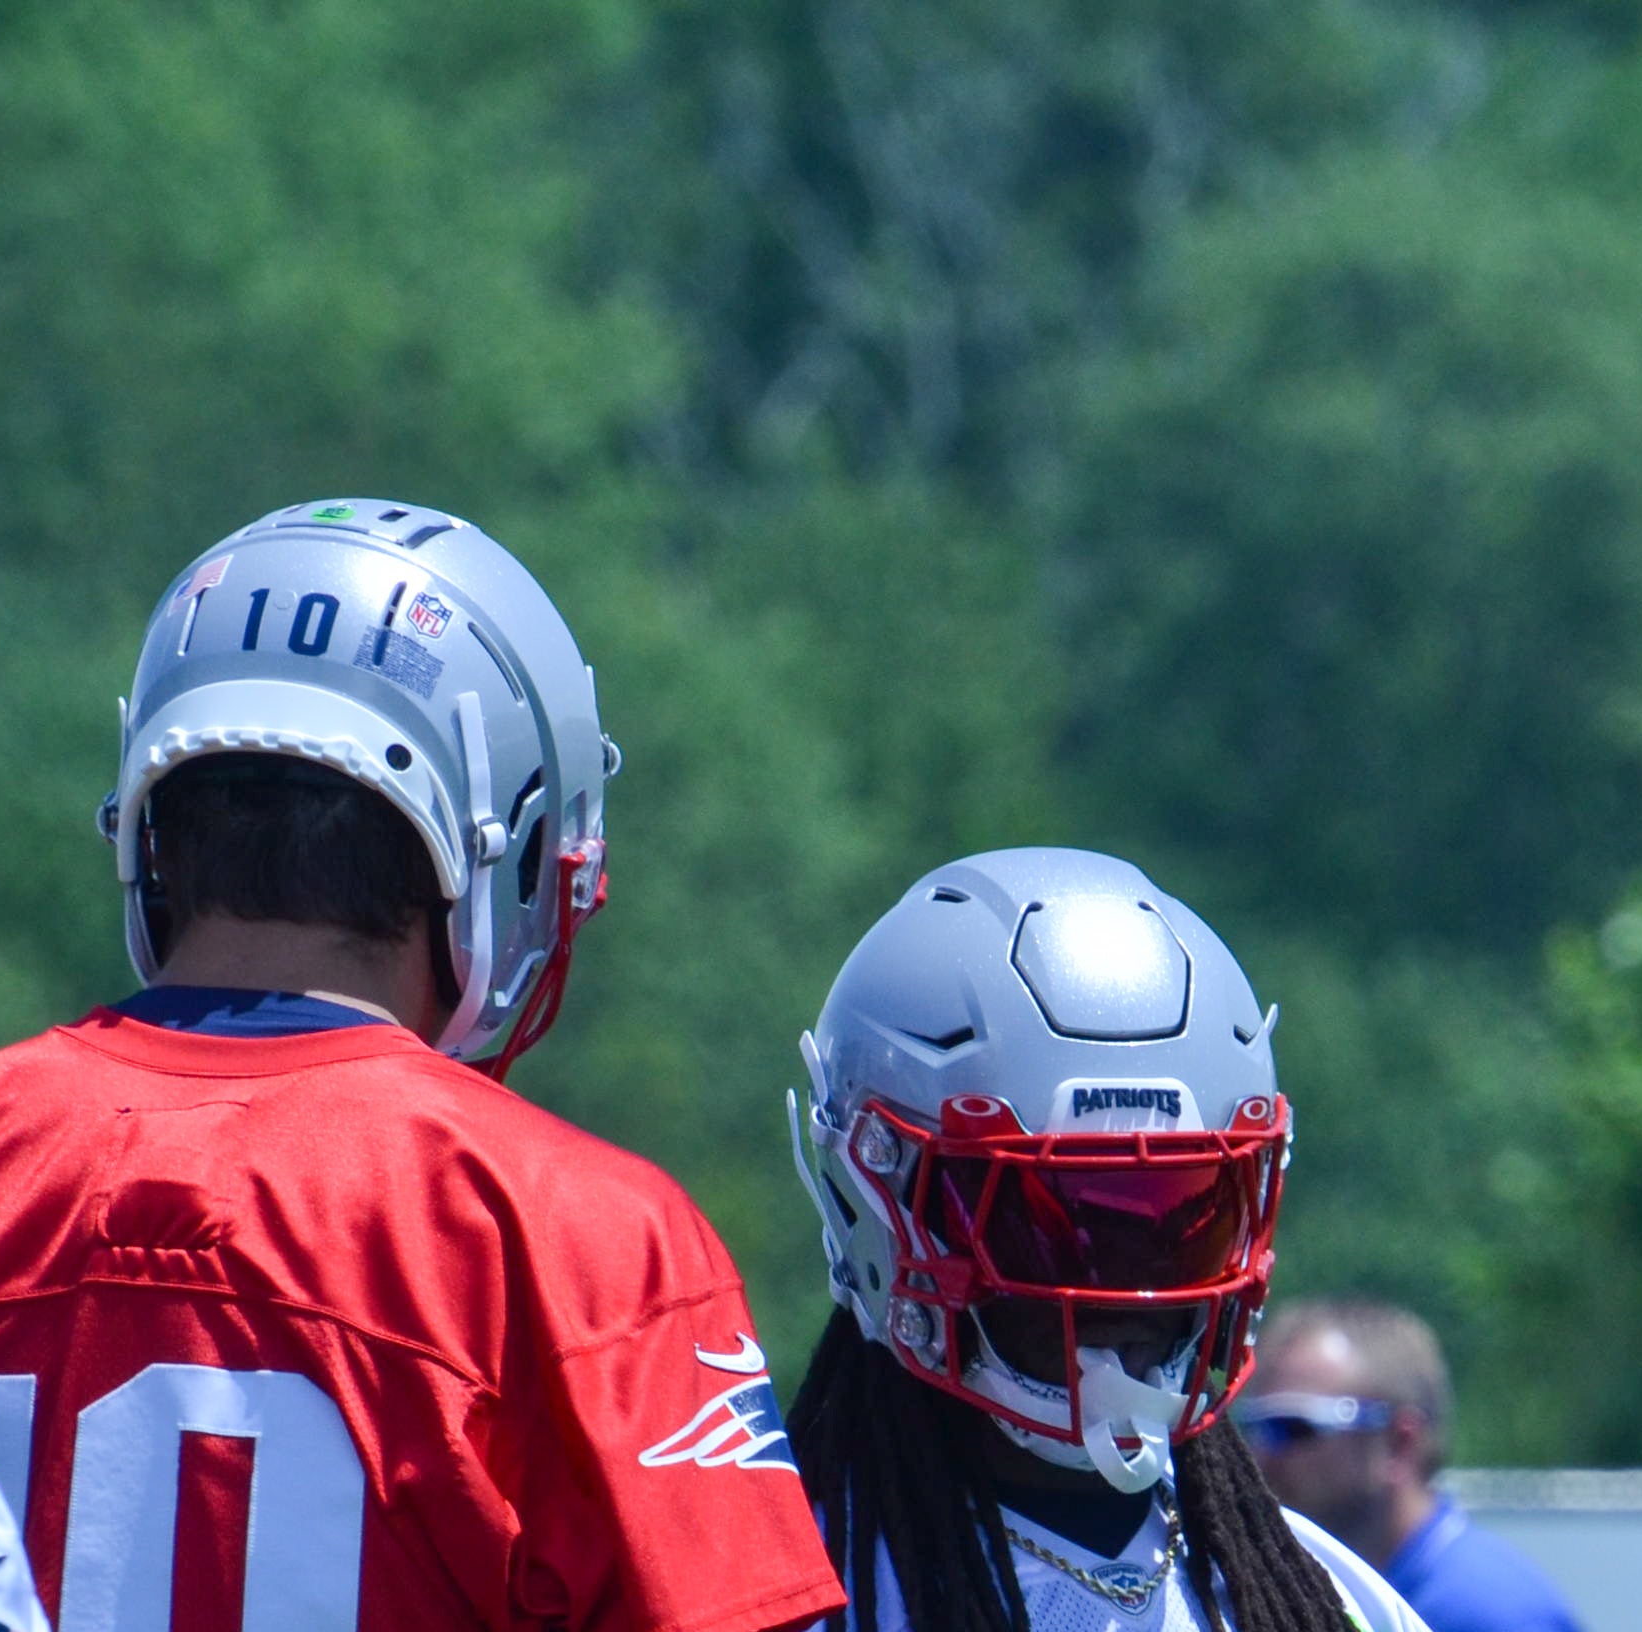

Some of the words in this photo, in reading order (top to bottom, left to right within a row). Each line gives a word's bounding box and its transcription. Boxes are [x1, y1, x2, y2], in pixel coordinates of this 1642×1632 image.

[242, 588, 340, 657] 10
[410, 603, 440, 635] NFL
[1073, 1088, 1182, 1118] PATRIOTS
